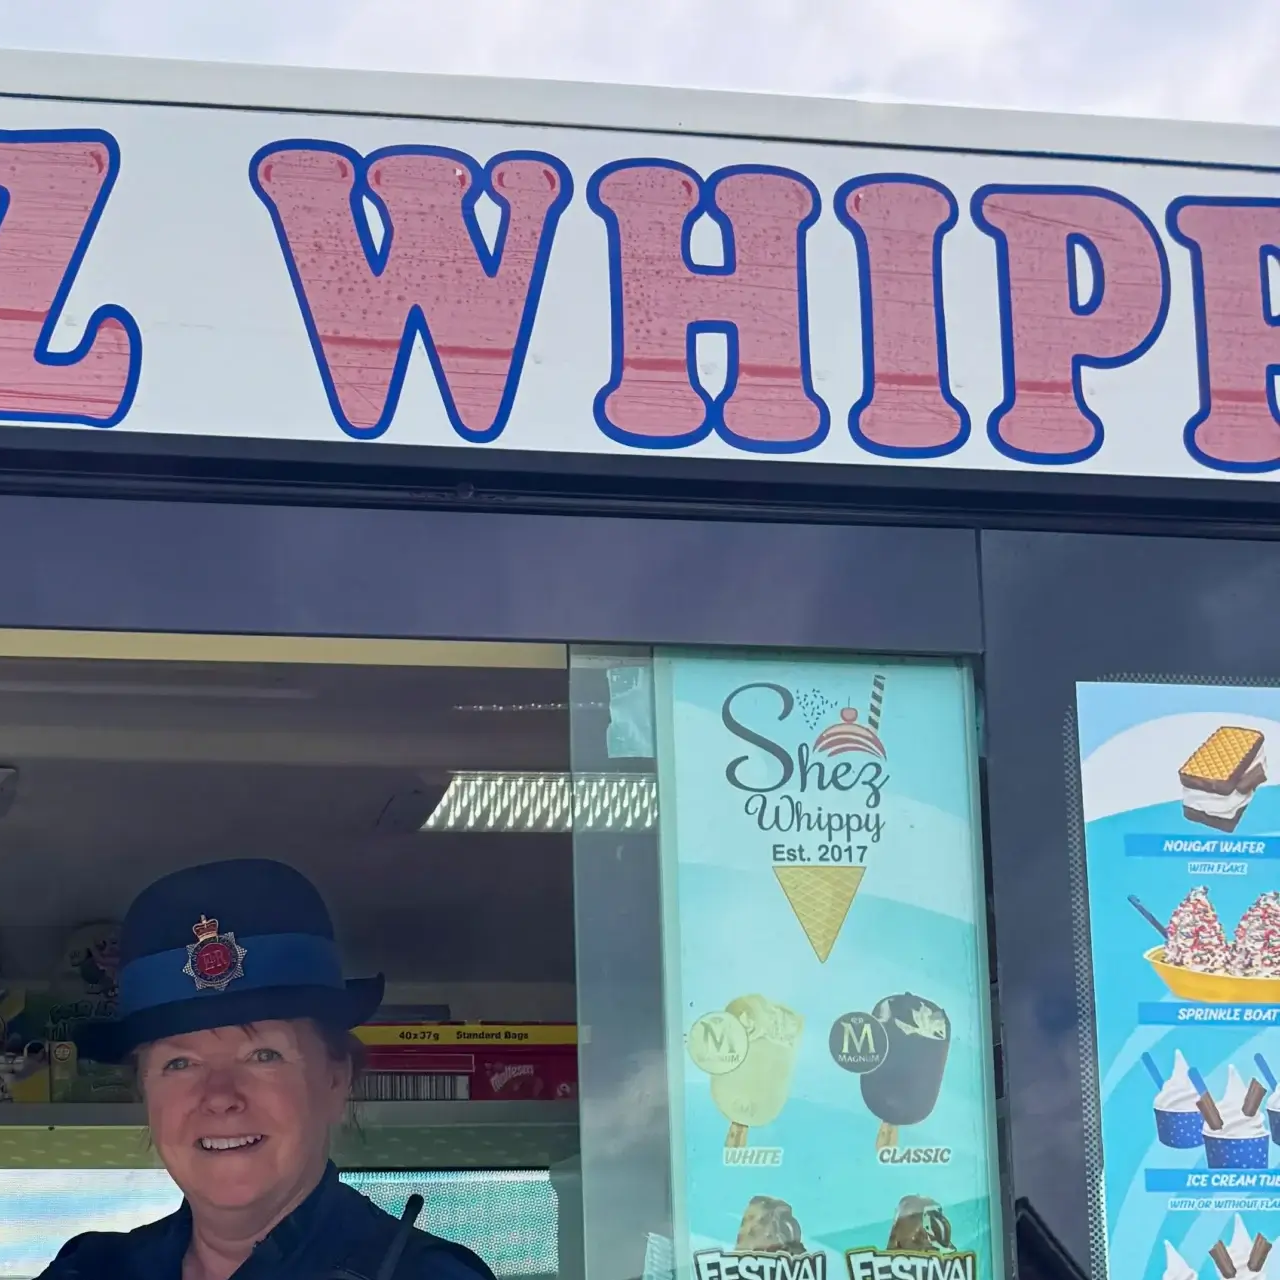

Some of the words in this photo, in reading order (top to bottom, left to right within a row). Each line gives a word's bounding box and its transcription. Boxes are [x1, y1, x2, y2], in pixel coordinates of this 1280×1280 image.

[722, 682, 890, 808] Shez
[744, 793, 886, 843] Whippy
[772, 844, 812, 863] Est.
[818, 844, 868, 863] 2017
[1163, 839, 1218, 854] NOUGAT
[1221, 840, 1265, 854] WAFER
[1190, 863, 1214, 874] WITH
[1216, 863, 1246, 874] FLAKE
[1178, 1007, 1241, 1021] SPRINKLE
[1244, 1008, 1279, 1021] BOAT
[456, 1030, 502, 1040] Standard
[504, 1030, 529, 1041] Bags
[700, 1021, 736, 1054] M
[840, 1021, 876, 1054] M
[723, 1148, 783, 1166] WHITE
[878, 1148, 951, 1164] CLASSIC
[1186, 1174, 1208, 1187] ICE
[1211, 1174, 1257, 1187] CREAM
[1170, 1199, 1195, 1209] WITH
[1198, 1199, 1212, 1209] OR
[1214, 1199, 1259, 1209] WITHOUT
